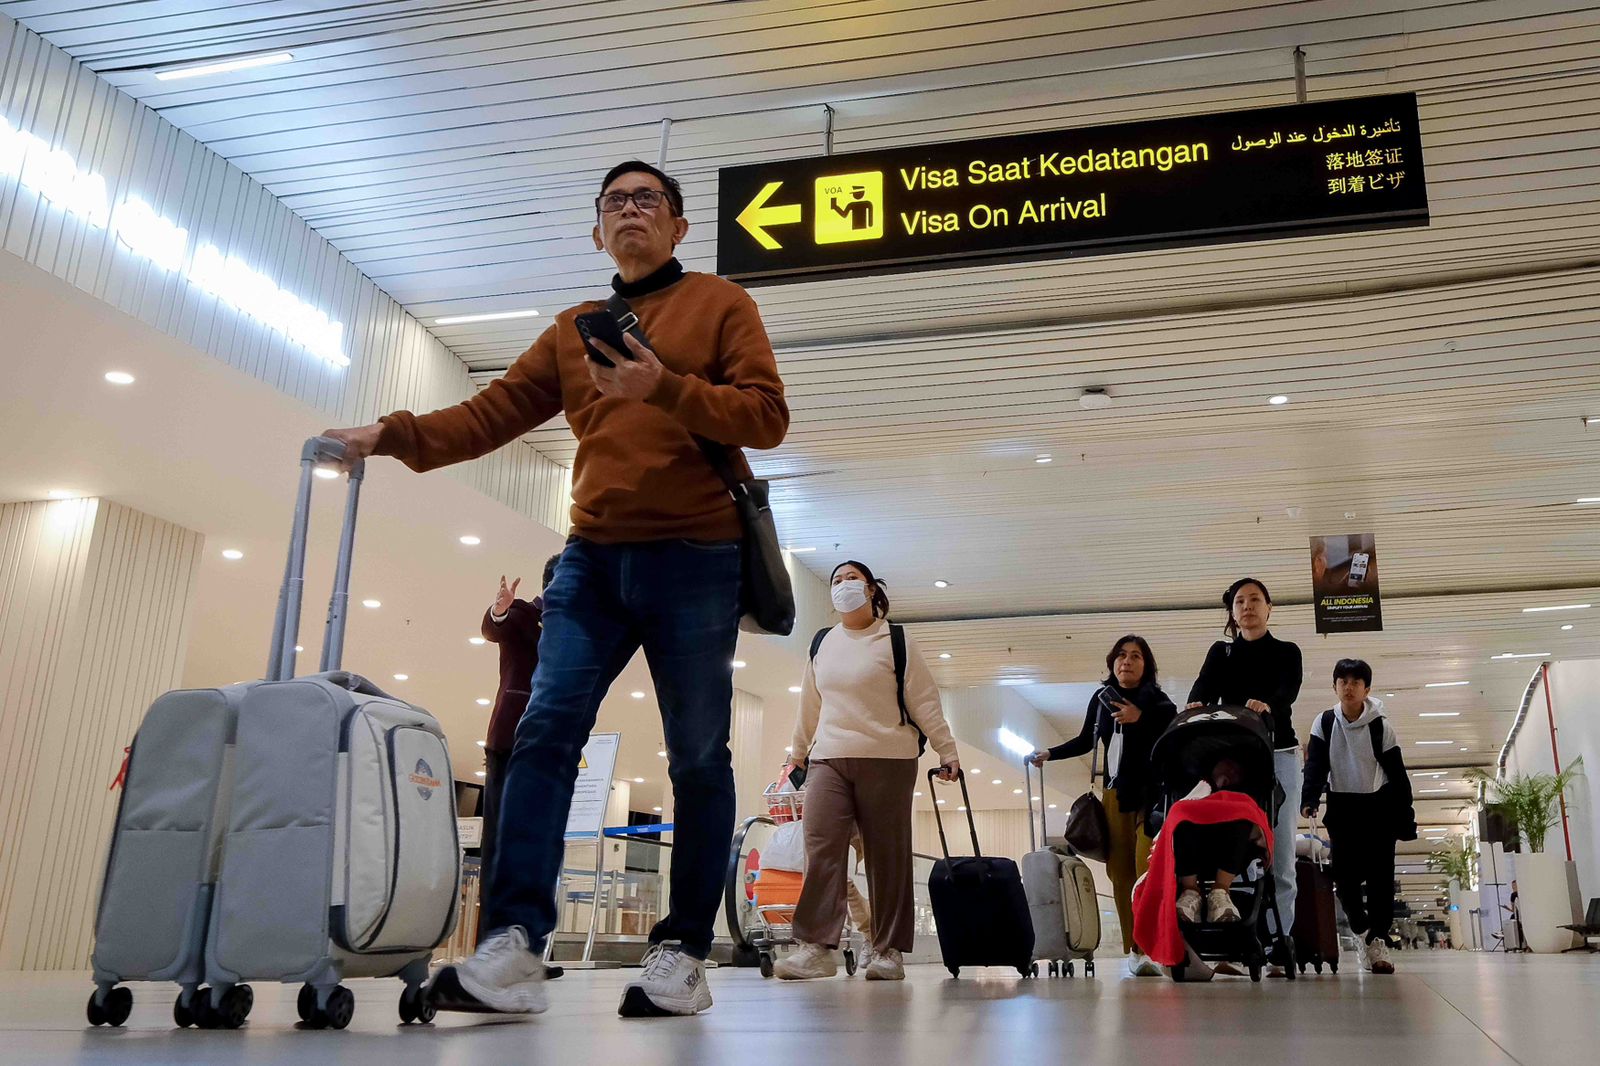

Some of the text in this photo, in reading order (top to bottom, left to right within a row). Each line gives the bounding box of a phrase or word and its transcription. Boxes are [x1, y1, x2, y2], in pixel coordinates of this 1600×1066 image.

[1231, 118, 1401, 151] تأشيرة الدخول عند الوصول
[900, 142, 1209, 191] Visa Saat Kedatangan
[1326, 147, 1404, 171] 落地签证
[824, 186, 843, 195] VOA
[1327, 170, 1406, 195] 到着ビザ
[900, 193, 1107, 236] Visa On Arrival
[1334, 597, 1374, 605] INDONESIA
